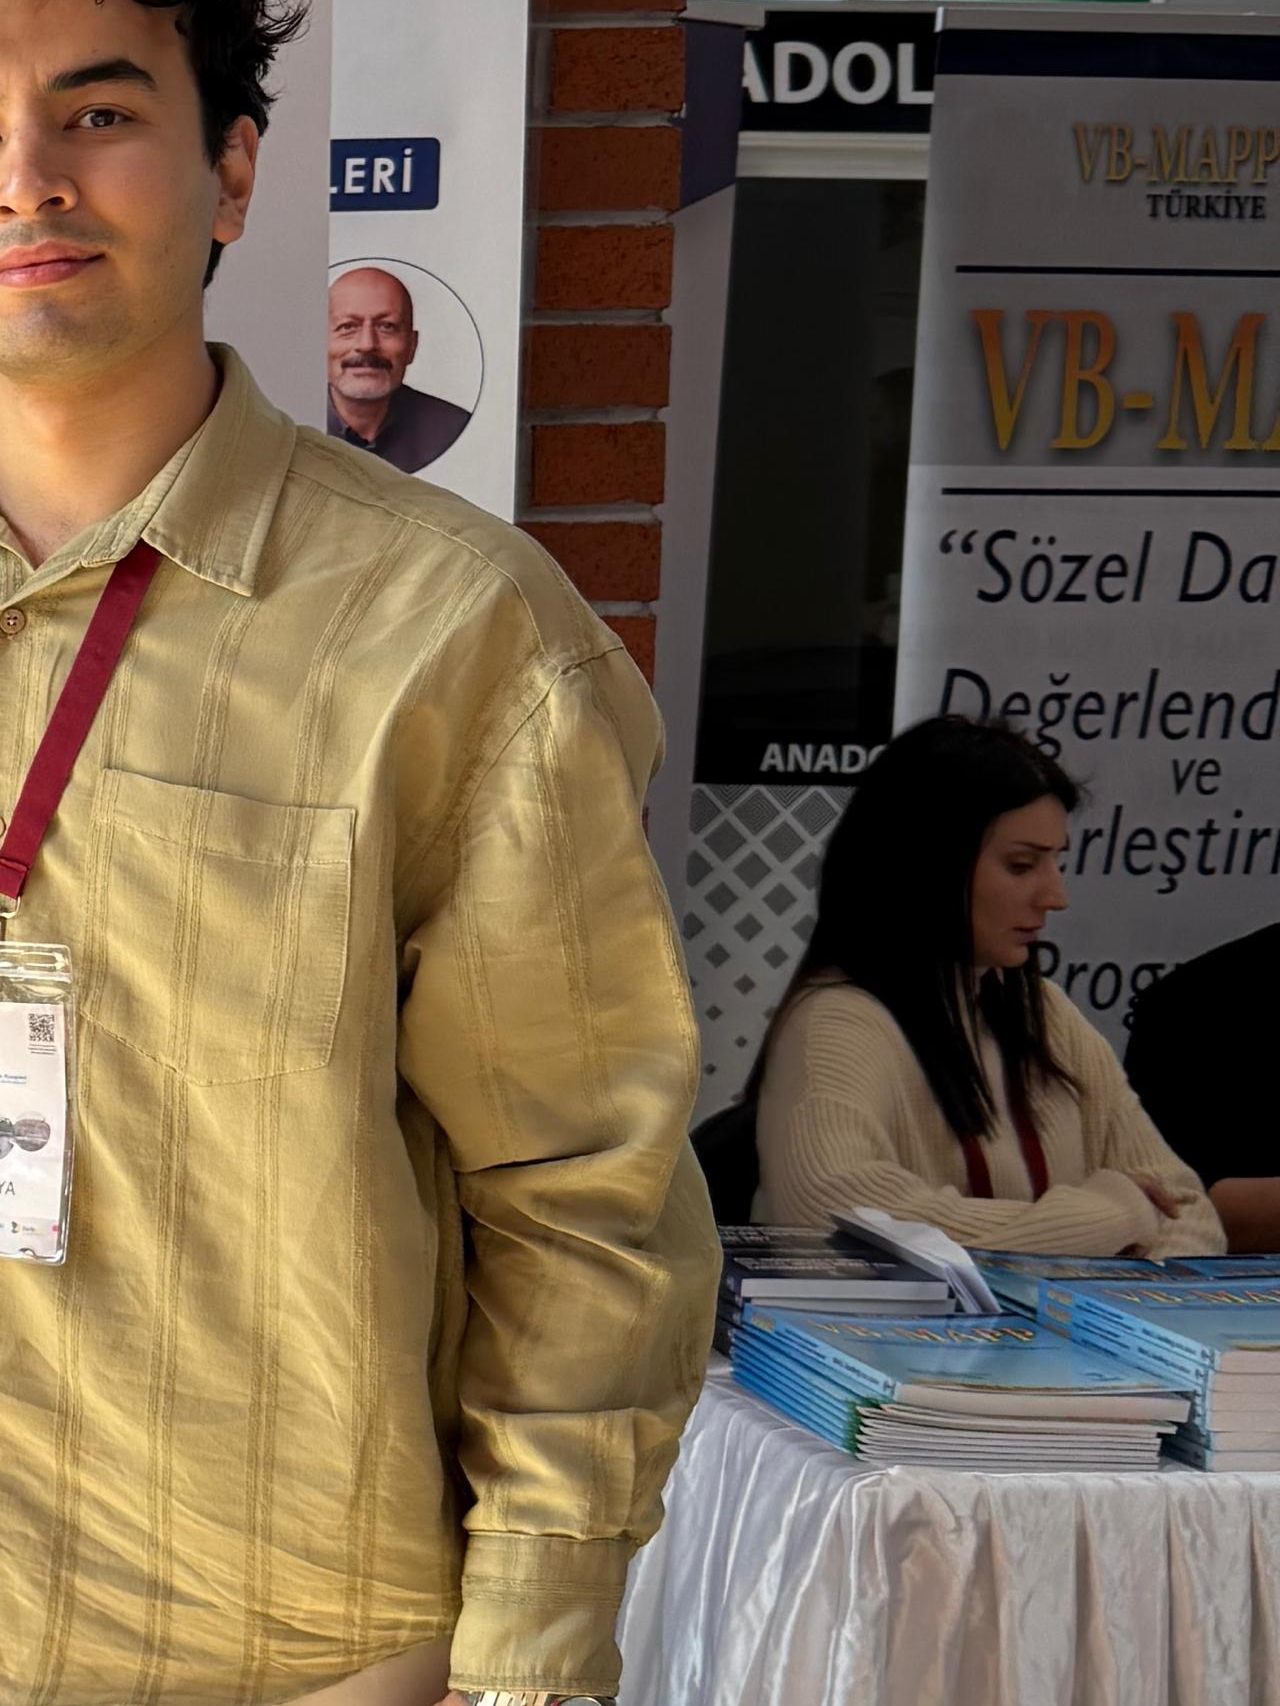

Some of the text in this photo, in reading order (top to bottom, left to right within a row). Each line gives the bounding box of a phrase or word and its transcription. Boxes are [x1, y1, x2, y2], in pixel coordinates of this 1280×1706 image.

[329, 147, 414, 194] ERİ
[1145, 190, 1267, 220] TÜRKİYE
[1172, 758, 1223, 796] ve
